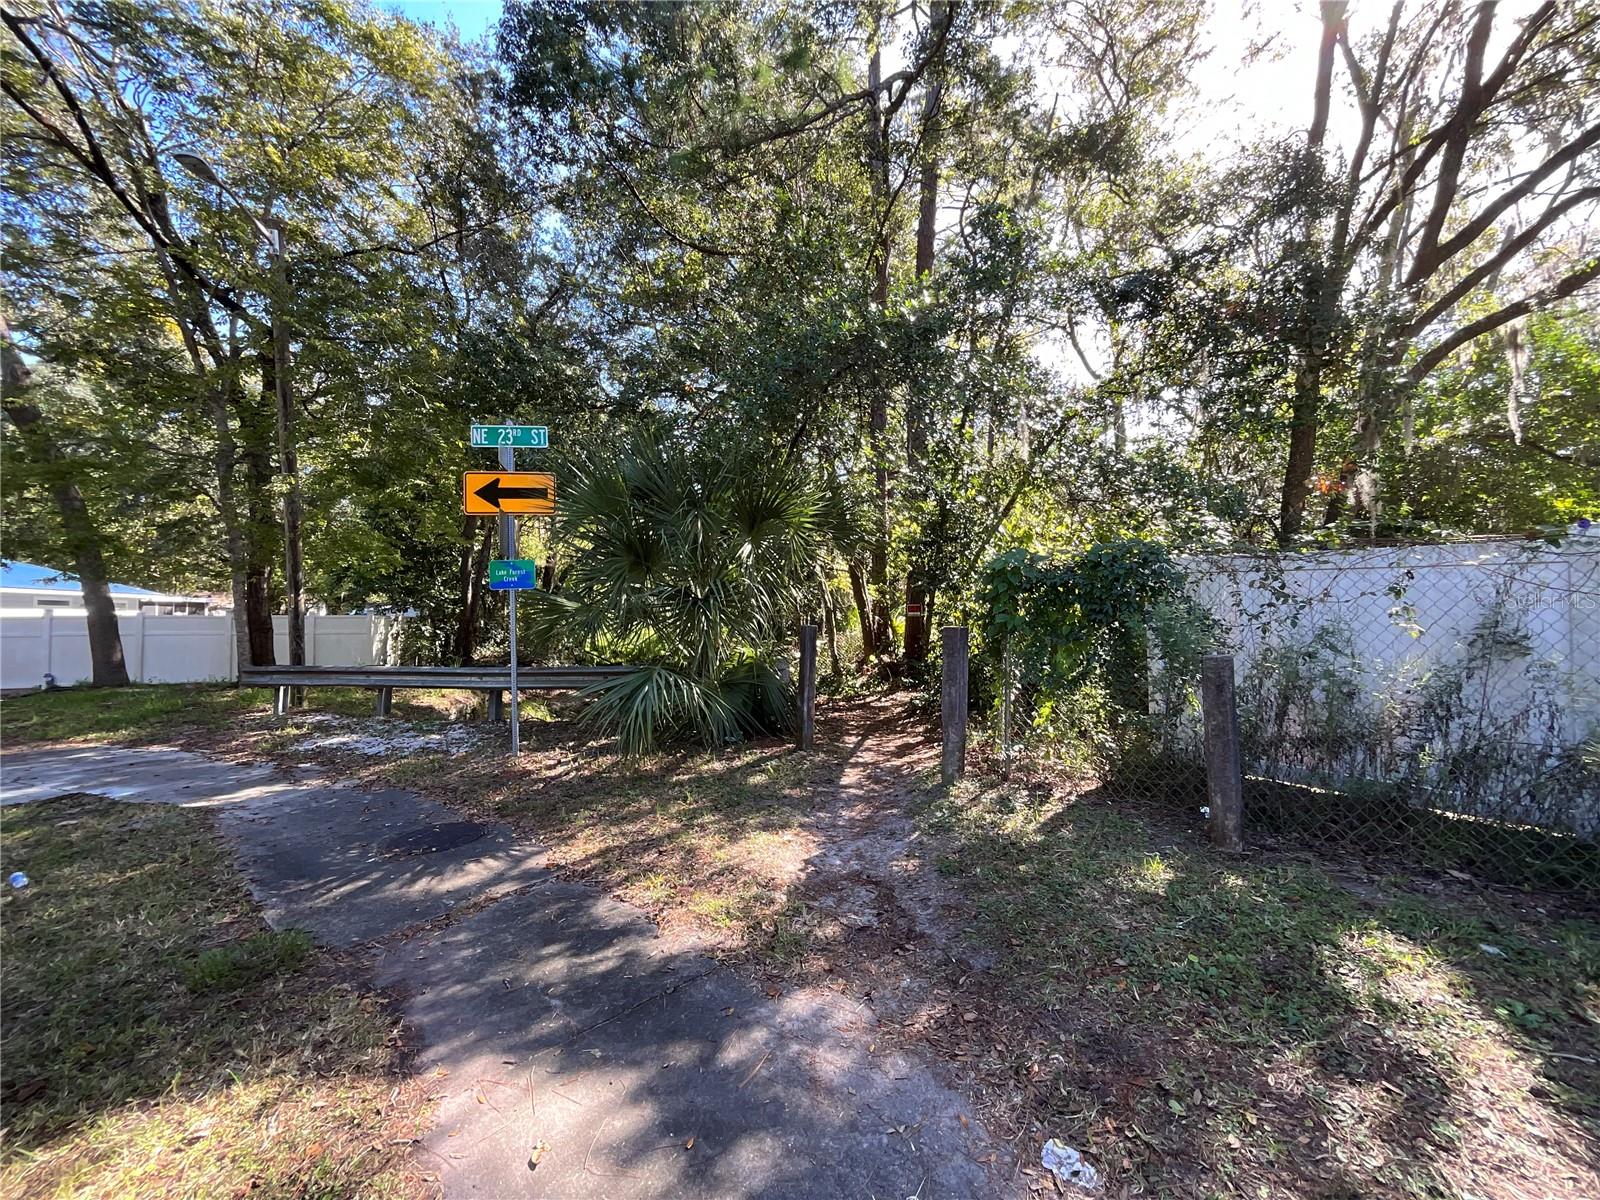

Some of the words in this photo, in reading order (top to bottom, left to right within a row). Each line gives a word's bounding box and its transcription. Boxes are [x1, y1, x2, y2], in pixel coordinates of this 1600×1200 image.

[473, 428, 489, 444] NE
[498, 428, 521, 445] 23RD
[531, 429, 545, 445] ST
